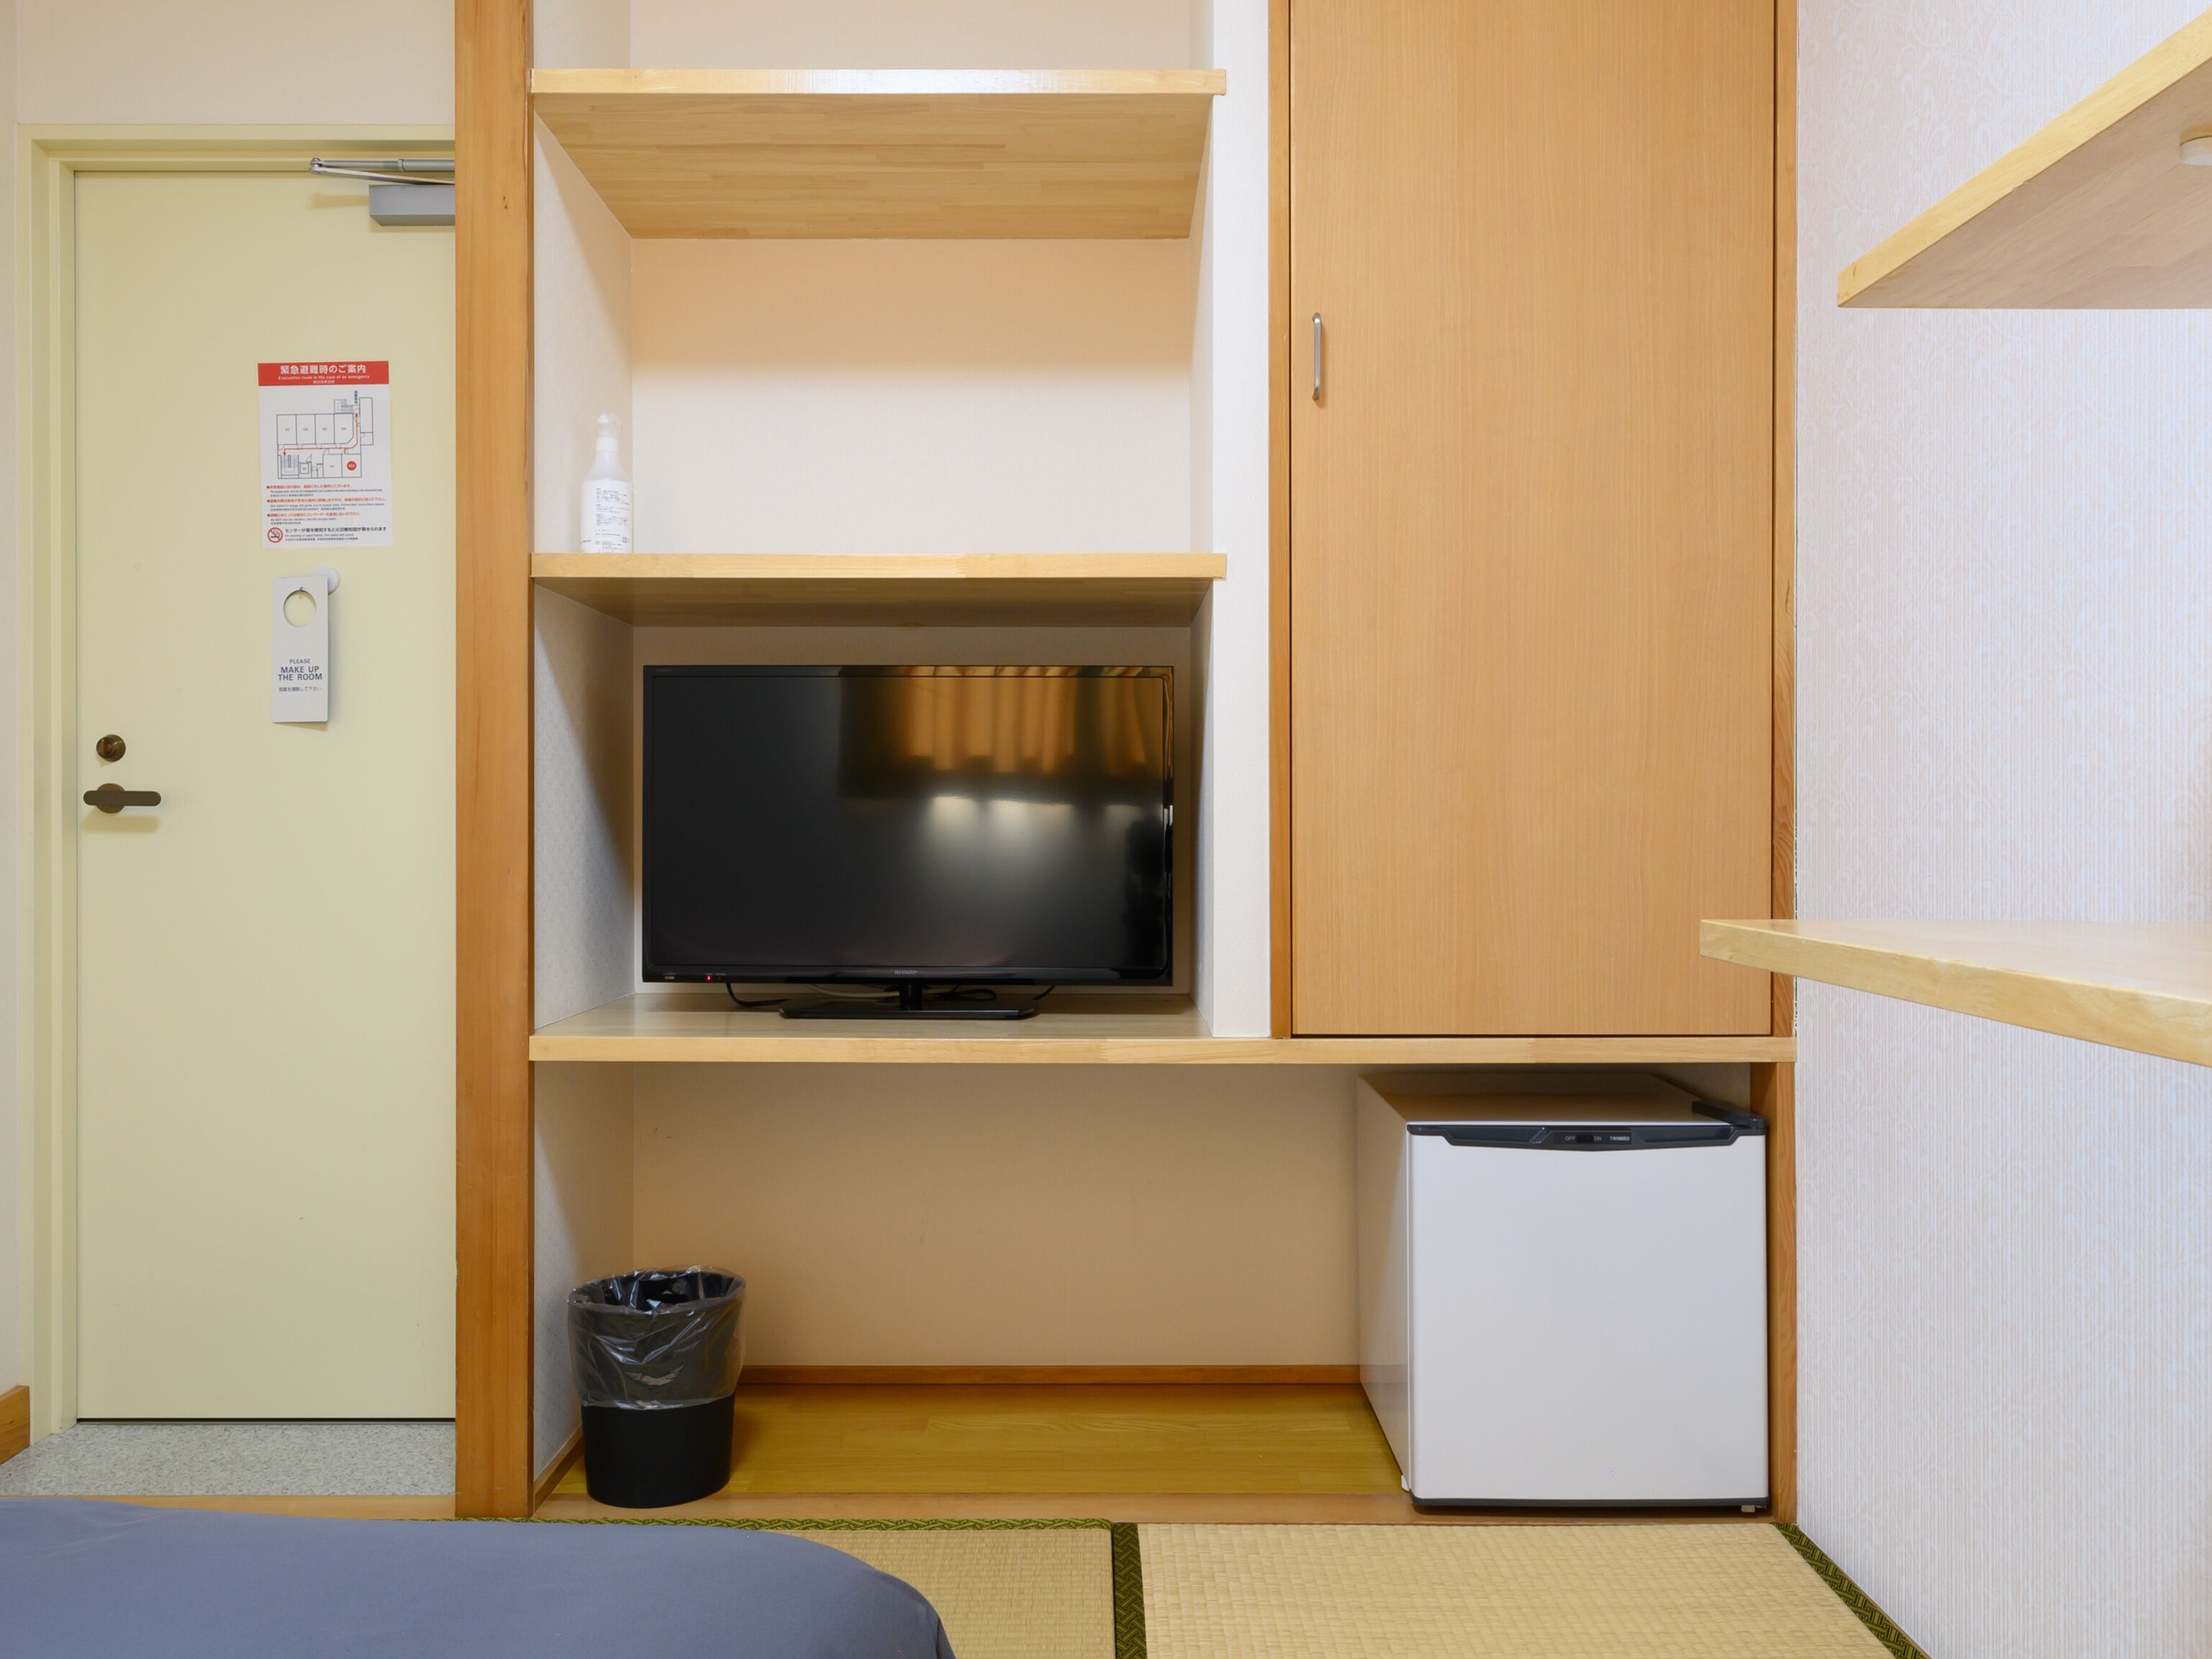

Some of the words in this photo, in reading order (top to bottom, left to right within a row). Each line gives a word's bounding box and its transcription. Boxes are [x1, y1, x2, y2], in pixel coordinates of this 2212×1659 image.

[280, 364, 366, 374] 緊急避難時のご案内
